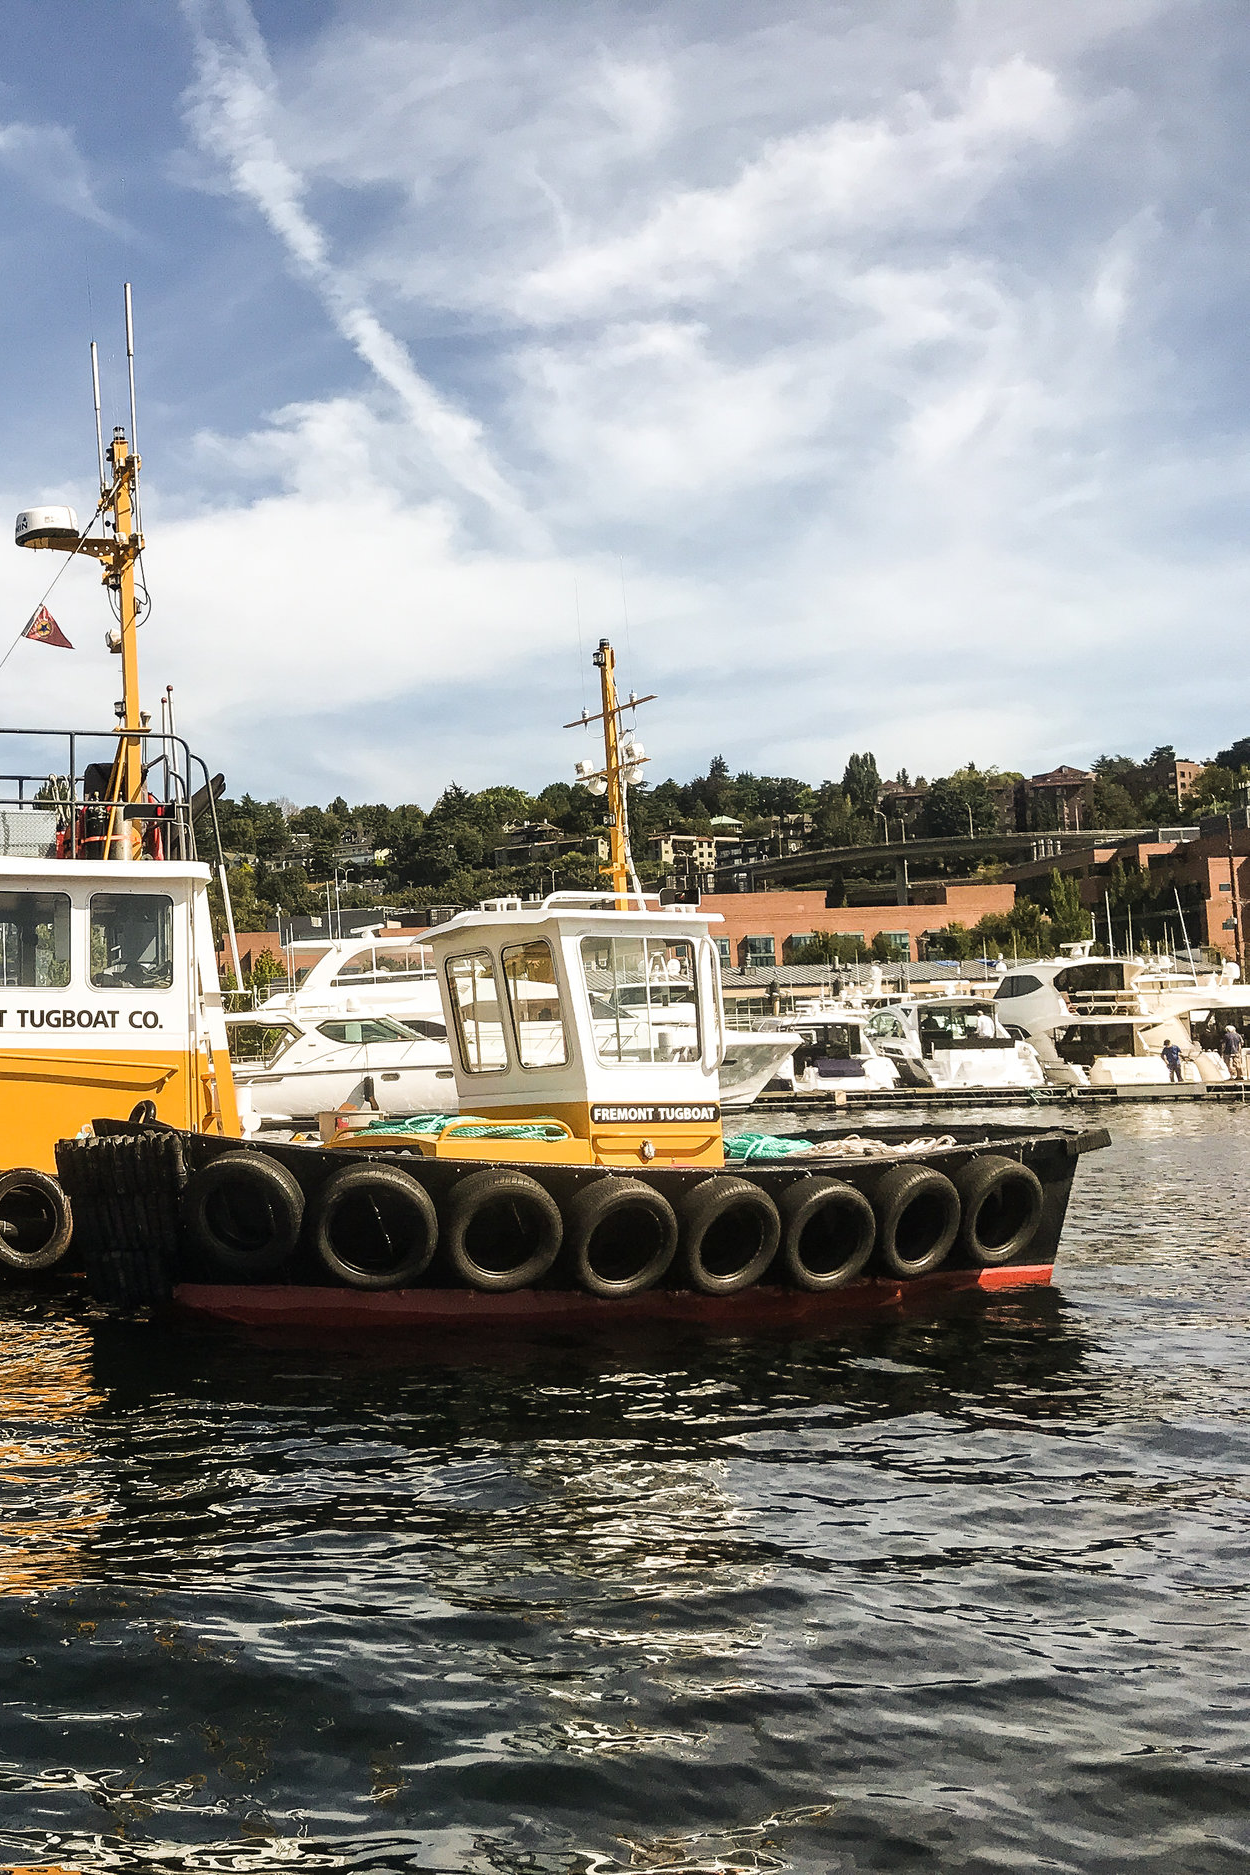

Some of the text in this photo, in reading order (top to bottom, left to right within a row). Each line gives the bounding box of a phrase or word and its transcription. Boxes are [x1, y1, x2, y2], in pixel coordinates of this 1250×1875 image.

[17, 1010, 120, 1029] TUGBOAT
[128, 1010, 164, 1030] CO.
[594, 1107, 716, 1120] FREMONT TUGBOAT
